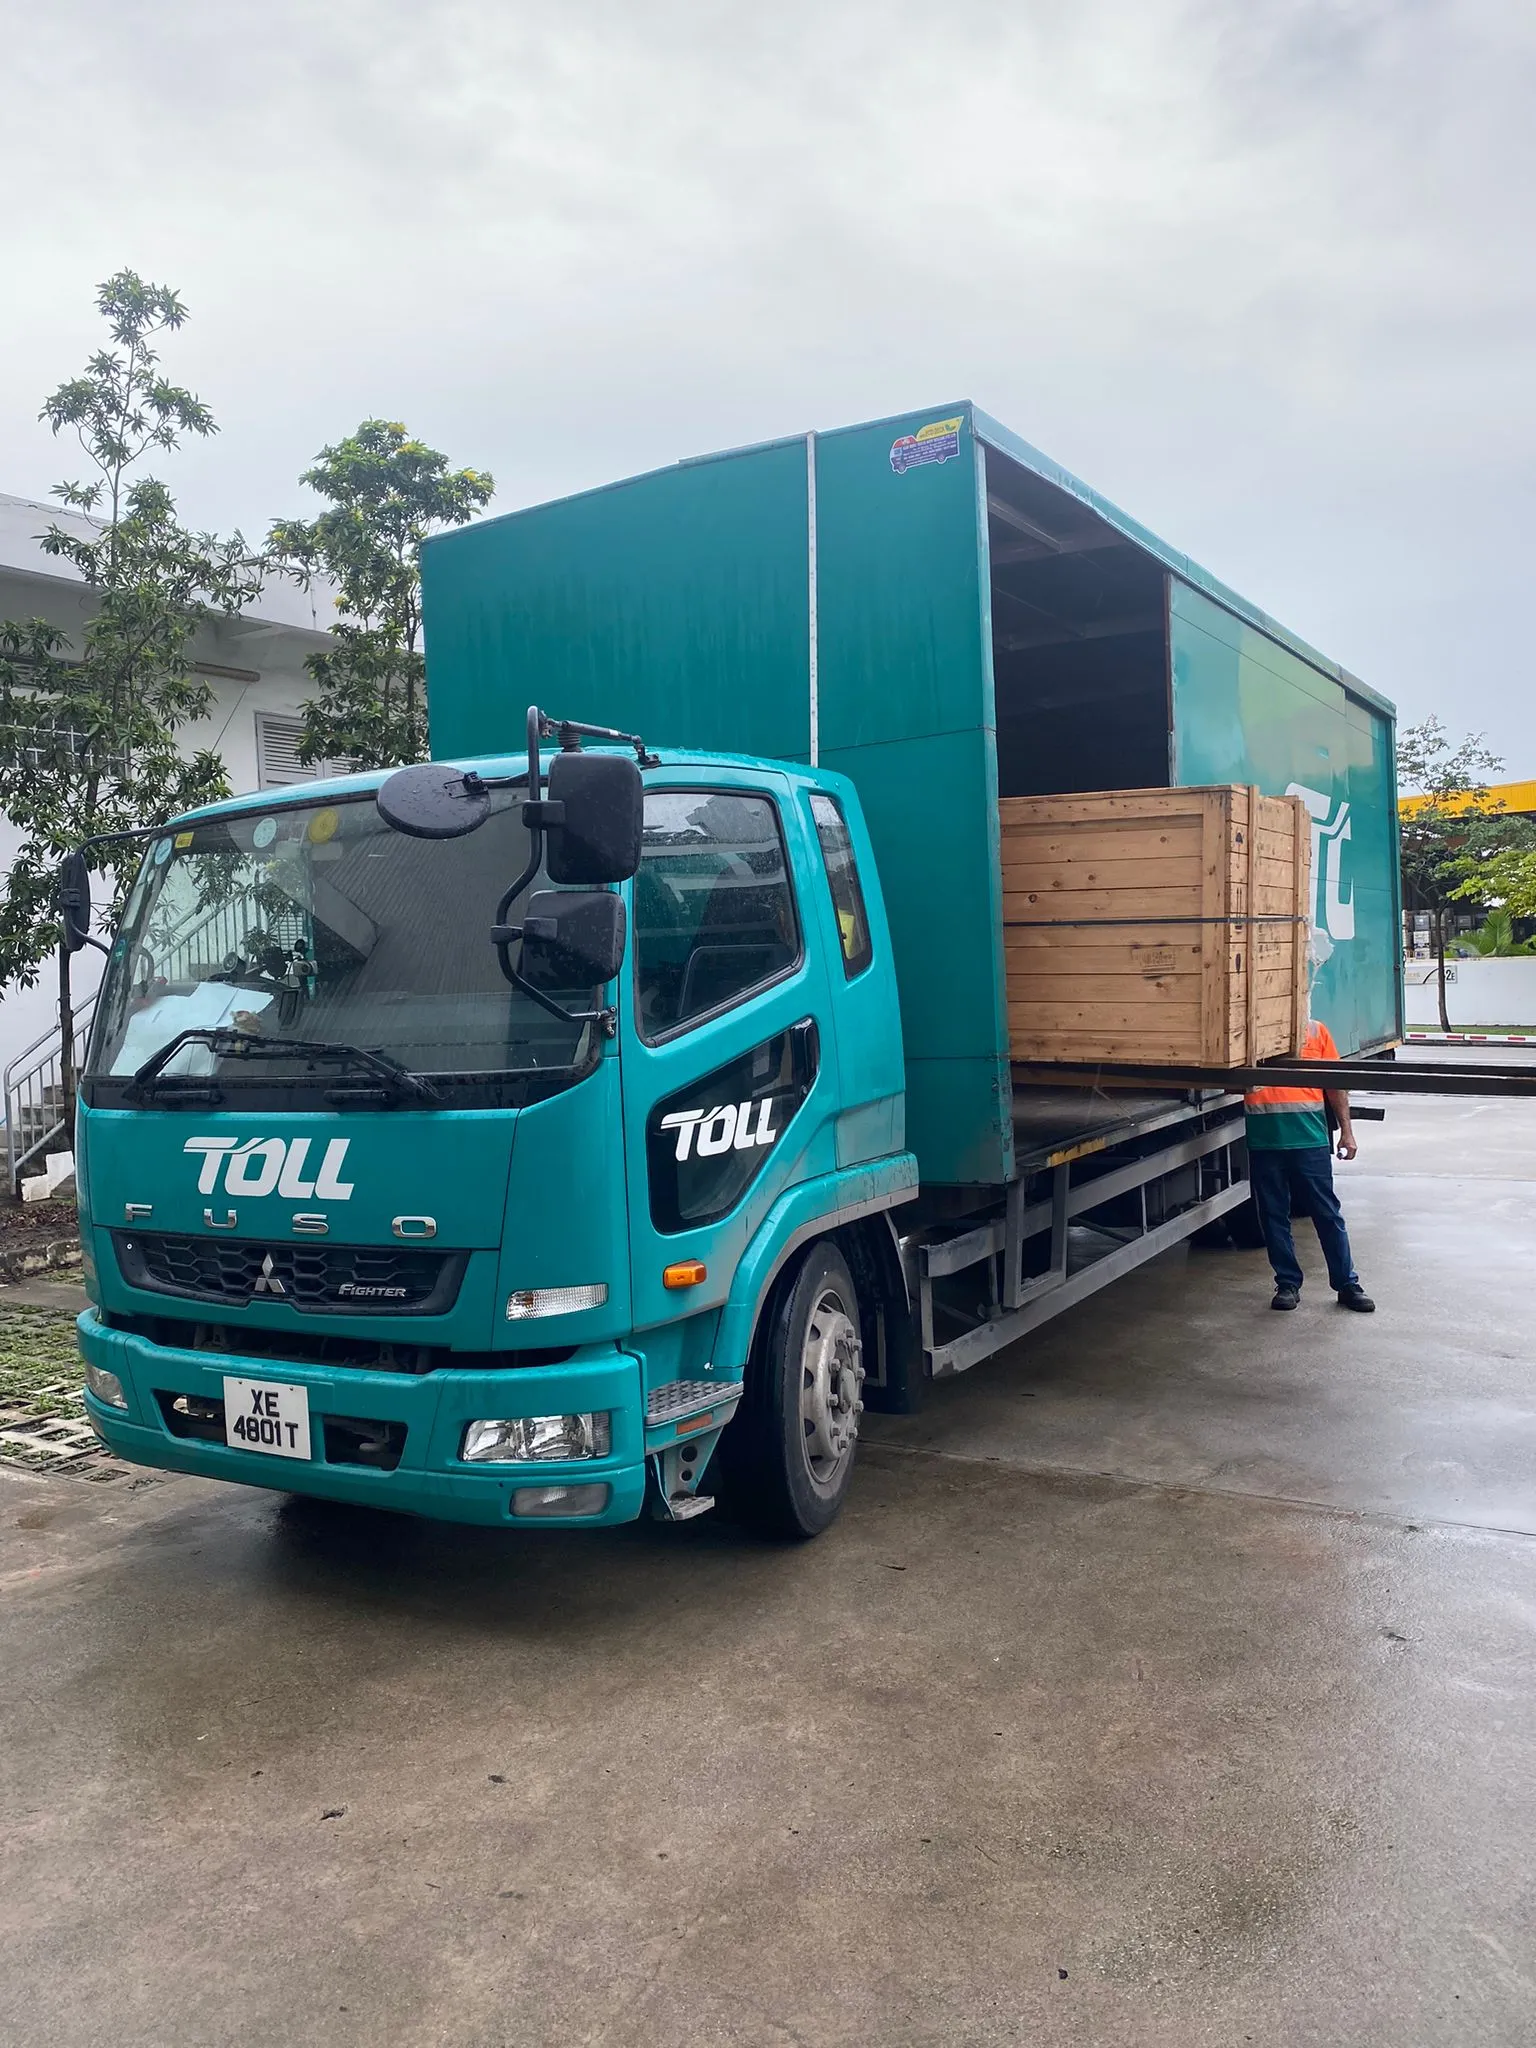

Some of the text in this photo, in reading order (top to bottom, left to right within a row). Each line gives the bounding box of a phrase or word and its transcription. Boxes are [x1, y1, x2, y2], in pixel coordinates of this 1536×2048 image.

[1445, 969, 1456, 981] 2E
[661, 1098, 776, 1162] TOLL
[183, 1137, 354, 1200] TOLL
[125, 1203, 436, 1238] FUSO
[339, 1284, 406, 1297] FIGHTER
[251, 1389, 280, 1417] XE
[233, 1415, 299, 1449] 4801T
